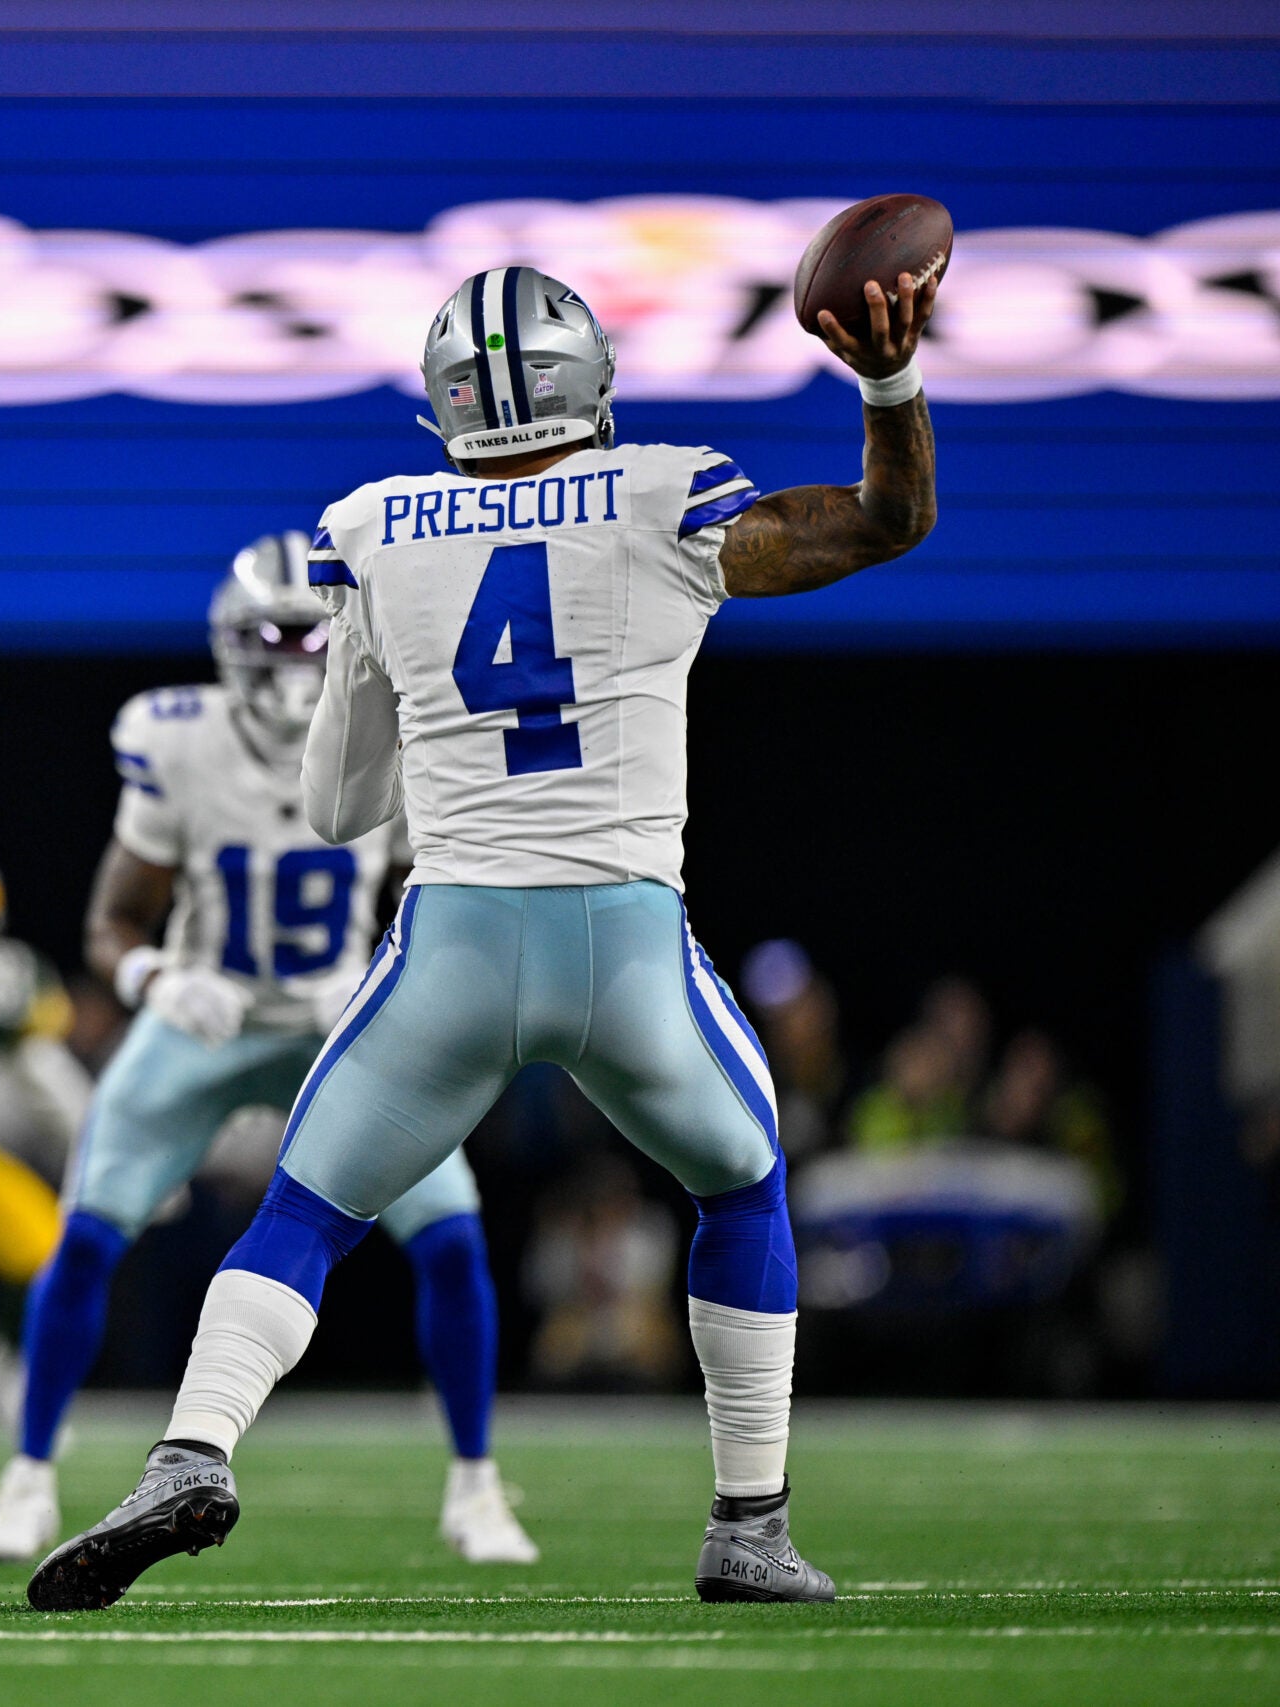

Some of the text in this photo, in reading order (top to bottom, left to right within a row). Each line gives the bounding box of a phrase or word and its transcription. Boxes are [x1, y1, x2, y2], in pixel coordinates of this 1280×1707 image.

[464, 426, 566, 451] IT TAKES ALL OF US
[381, 468, 624, 546] PRESCOTT
[452, 541, 583, 777] 4
[216, 845, 357, 978] 19
[173, 1473, 228, 1492] D4K-04
[721, 1558, 768, 1583] D4K-04
